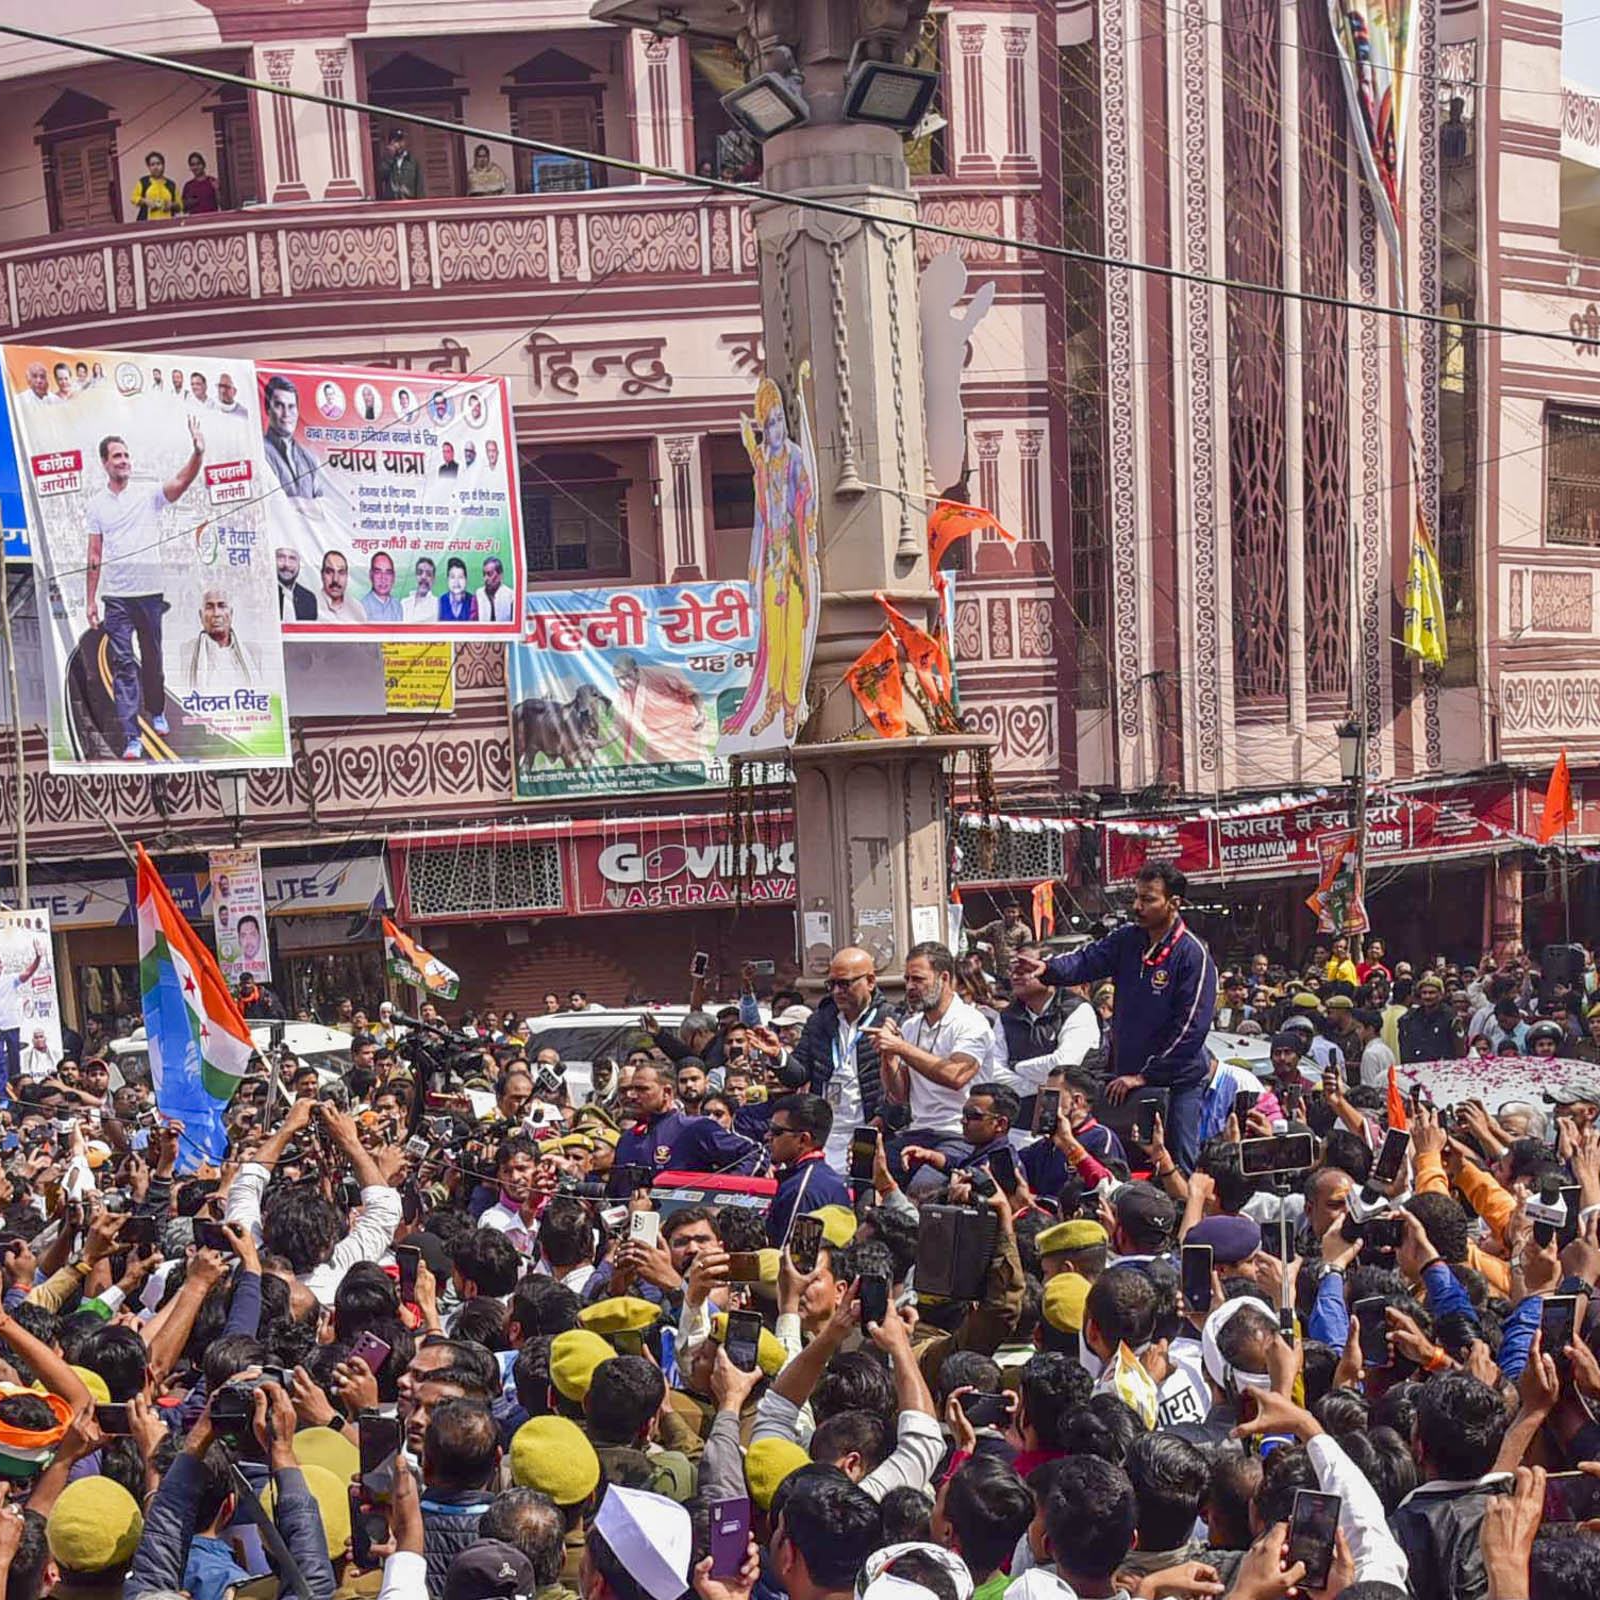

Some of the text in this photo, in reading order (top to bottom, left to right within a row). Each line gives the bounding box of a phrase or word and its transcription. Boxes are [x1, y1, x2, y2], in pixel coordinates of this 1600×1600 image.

[525, 333, 674, 396] हिन्दू
[328, 448, 425, 475] न्याय यात्रा
[524, 588, 750, 652] पहली रोटी
[688, 654, 727, 674] यह
[181, 688, 270, 712] दौलत सिंह
[262, 876, 319, 902] LITE
